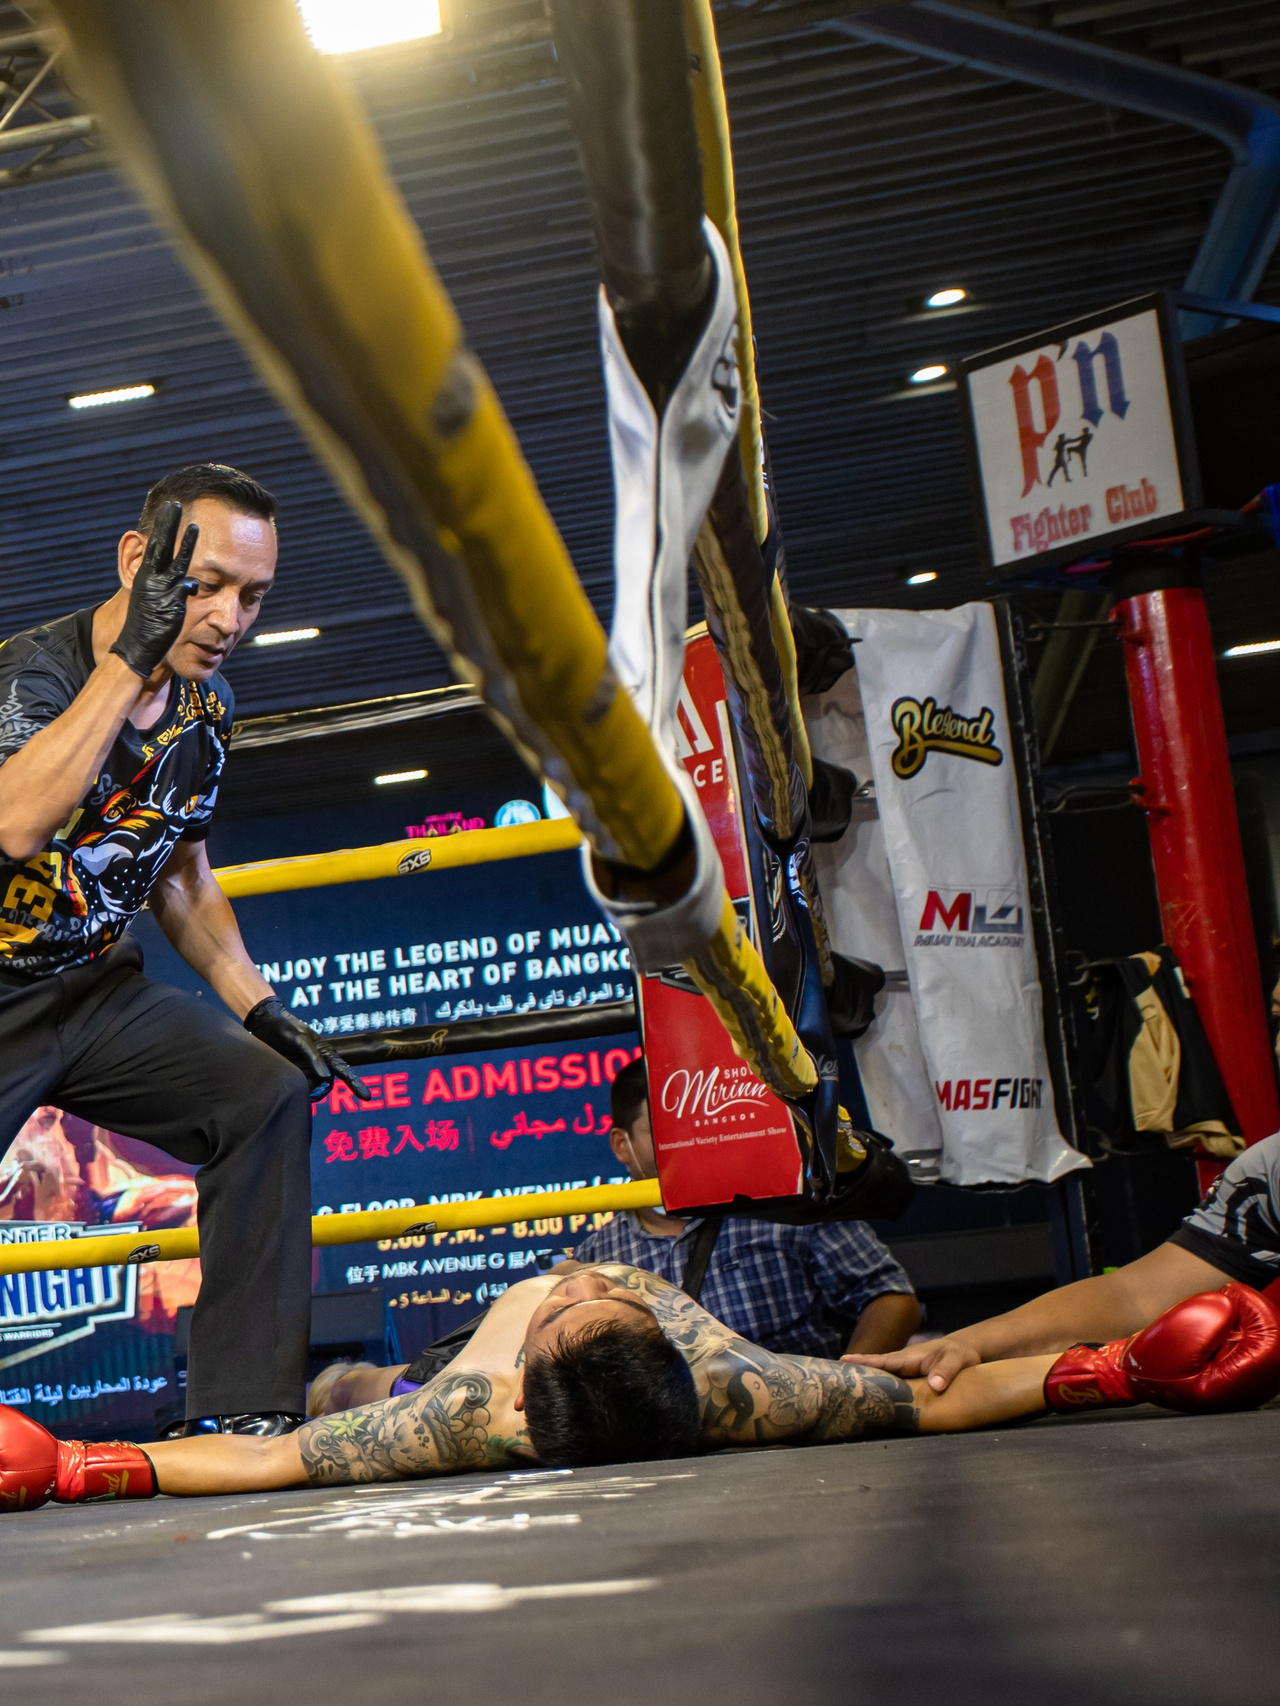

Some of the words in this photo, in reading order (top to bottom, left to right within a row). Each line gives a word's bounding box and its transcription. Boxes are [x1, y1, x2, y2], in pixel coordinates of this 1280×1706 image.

[1009, 503, 1092, 554] Fighter
[1104, 477, 1158, 525] Club
[404, 816, 485, 838] THAILAND
[398, 849, 431, 875] SXS
[334, 949, 387, 975] THE
[394, 937, 498, 968] LEGEND
[506, 930, 541, 955] OF
[548, 922, 622, 950] MUAY
[290, 983, 322, 1009] AT
[329, 977, 381, 1003] THE
[389, 966, 475, 997] HEART
[482, 961, 517, 986] OF
[300, 1006, 418, 1035] 心享受泰拳传奇
[422, 1046, 642, 1105] ADMISSIO
[661, 1066, 769, 1119] Mirinn
[934, 1077, 1043, 1111] MASFIGHT
[490, 1111, 567, 1149] مجاني
[694, 1112, 756, 1128] BANGKOK
[325, 1119, 460, 1163] 免费入场
[658, 1138, 696, 1151] International
[695, 1135, 718, 1146] Variety
[718, 1129, 766, 1142] Entertainment
[767, 1126, 788, 1136] Show
[128, 1244, 160, 1263] SXS
[345, 1264, 380, 1285] 位于
[381, 1260, 419, 1279] MBK
[420, 1253, 487, 1276] AVENUE
[487, 1252, 505, 1270] G
[411, 1287, 451, 1306] الساعة
[3, 1328, 55, 1342] WARRIORS
[33, 1383, 64, 1406] ليلة
[67, 1376, 131, 1401] المحاربين
[132, 1375, 168, 1394] عودة
